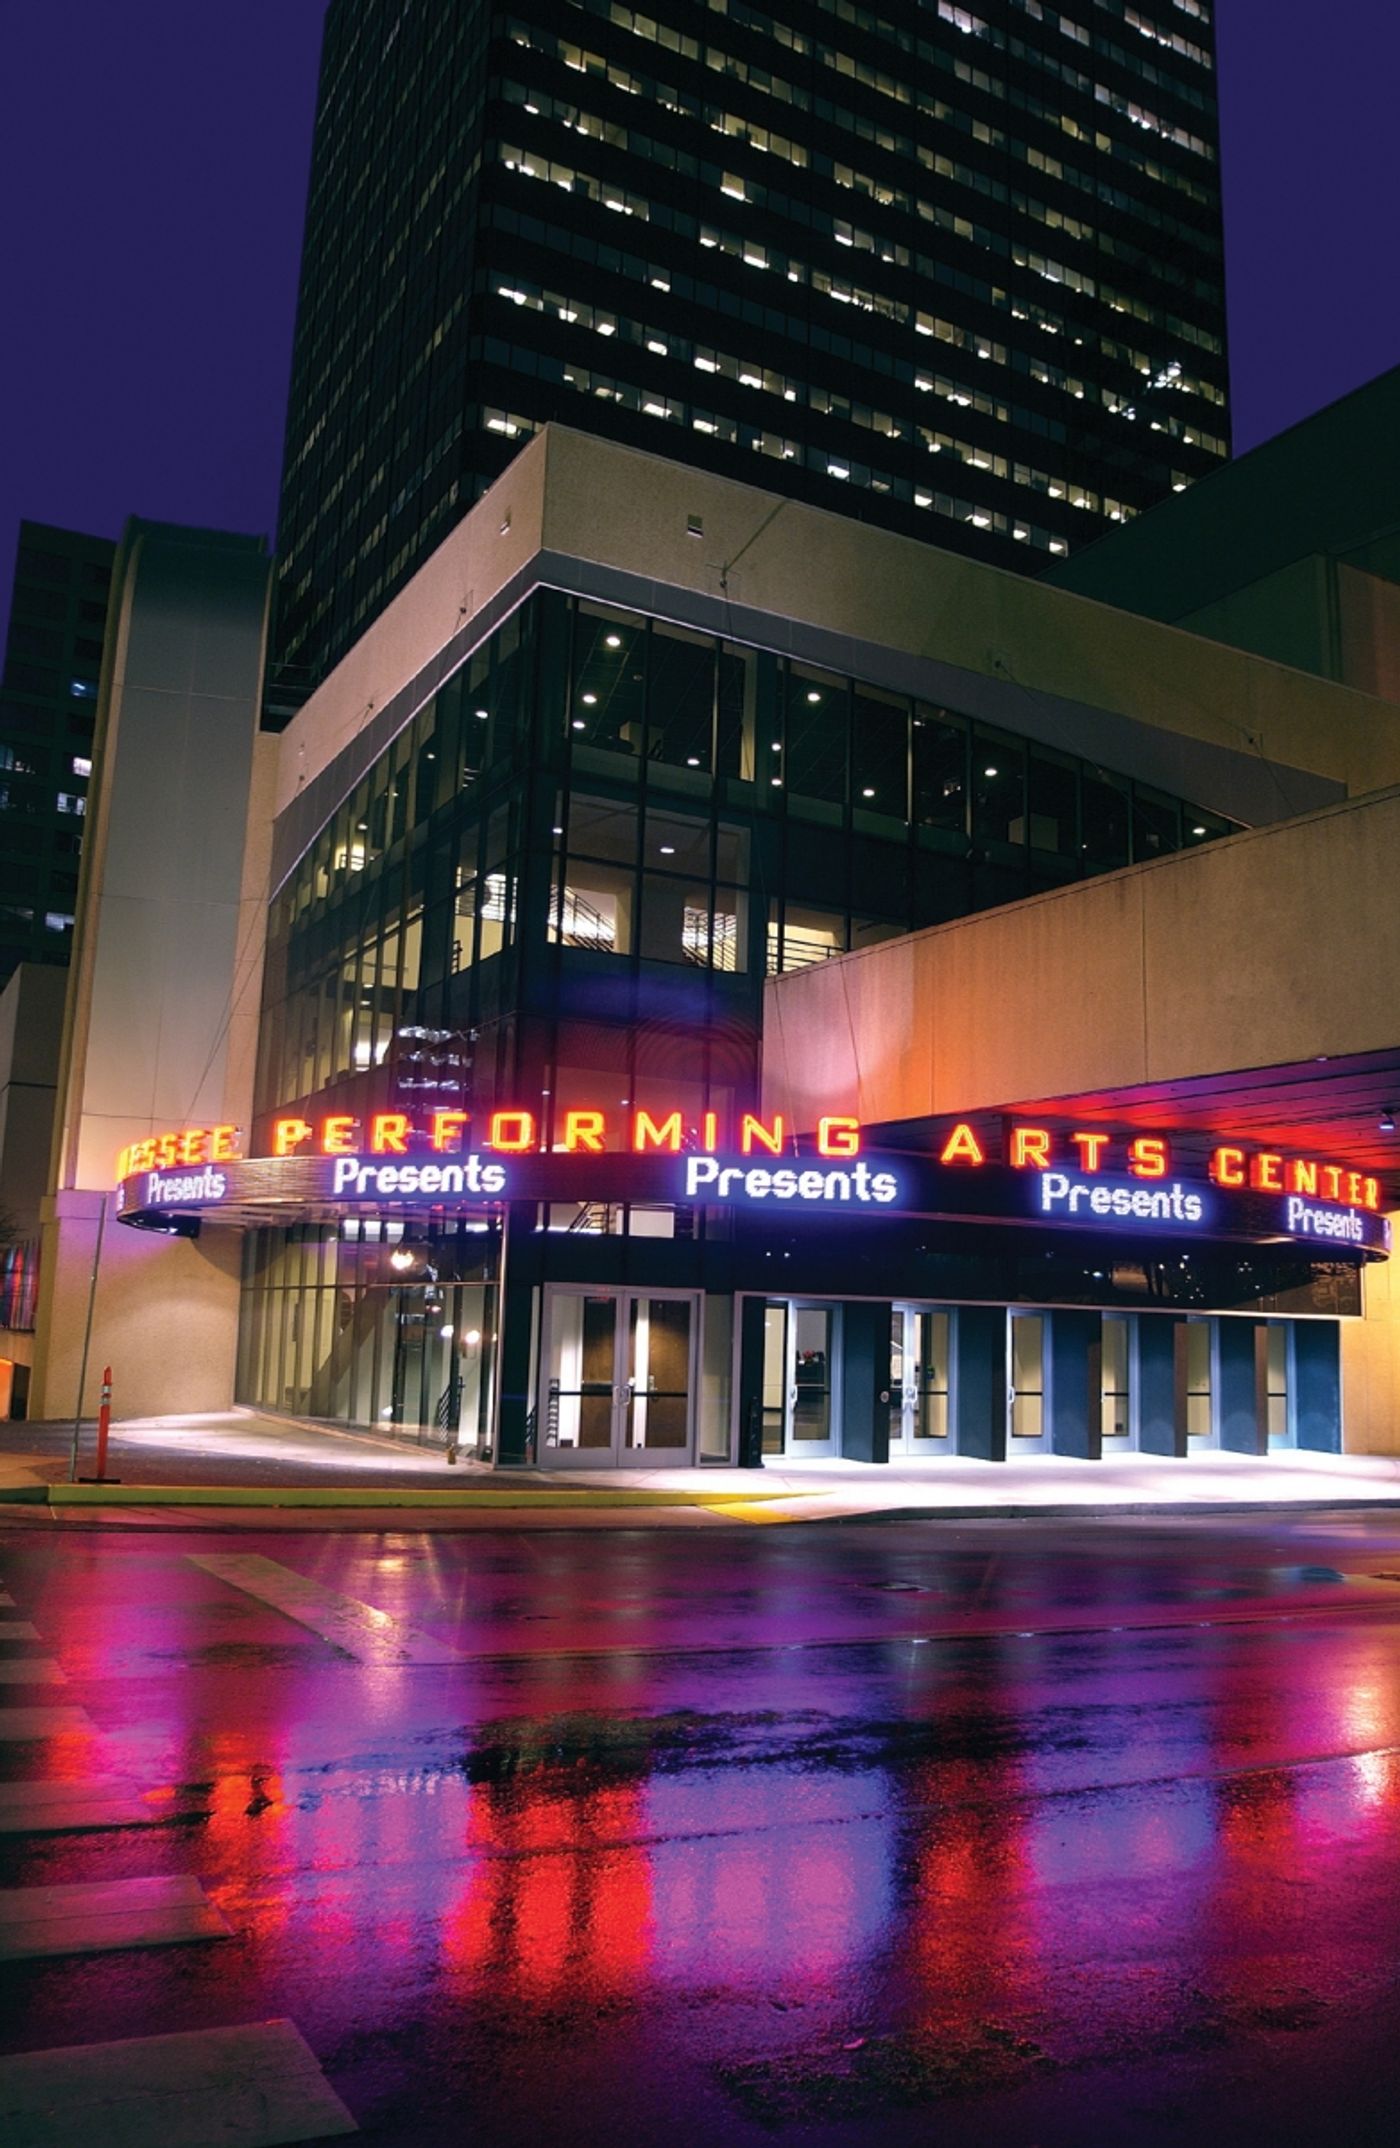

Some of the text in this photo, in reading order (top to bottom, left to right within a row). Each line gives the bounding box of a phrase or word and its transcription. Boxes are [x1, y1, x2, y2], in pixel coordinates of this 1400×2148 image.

[274, 1110, 861, 1157] PERFORMING
[940, 1124, 1167, 1178] ARTS
[1212, 1147, 1379, 1210] CENTER
[332, 1153, 506, 1195] Presents
[685, 1156, 897, 1203] Presents
[145, 1165, 226, 1204] Presents
[1041, 1171, 1202, 1222] Presents
[1286, 1195, 1363, 1241] Presents
